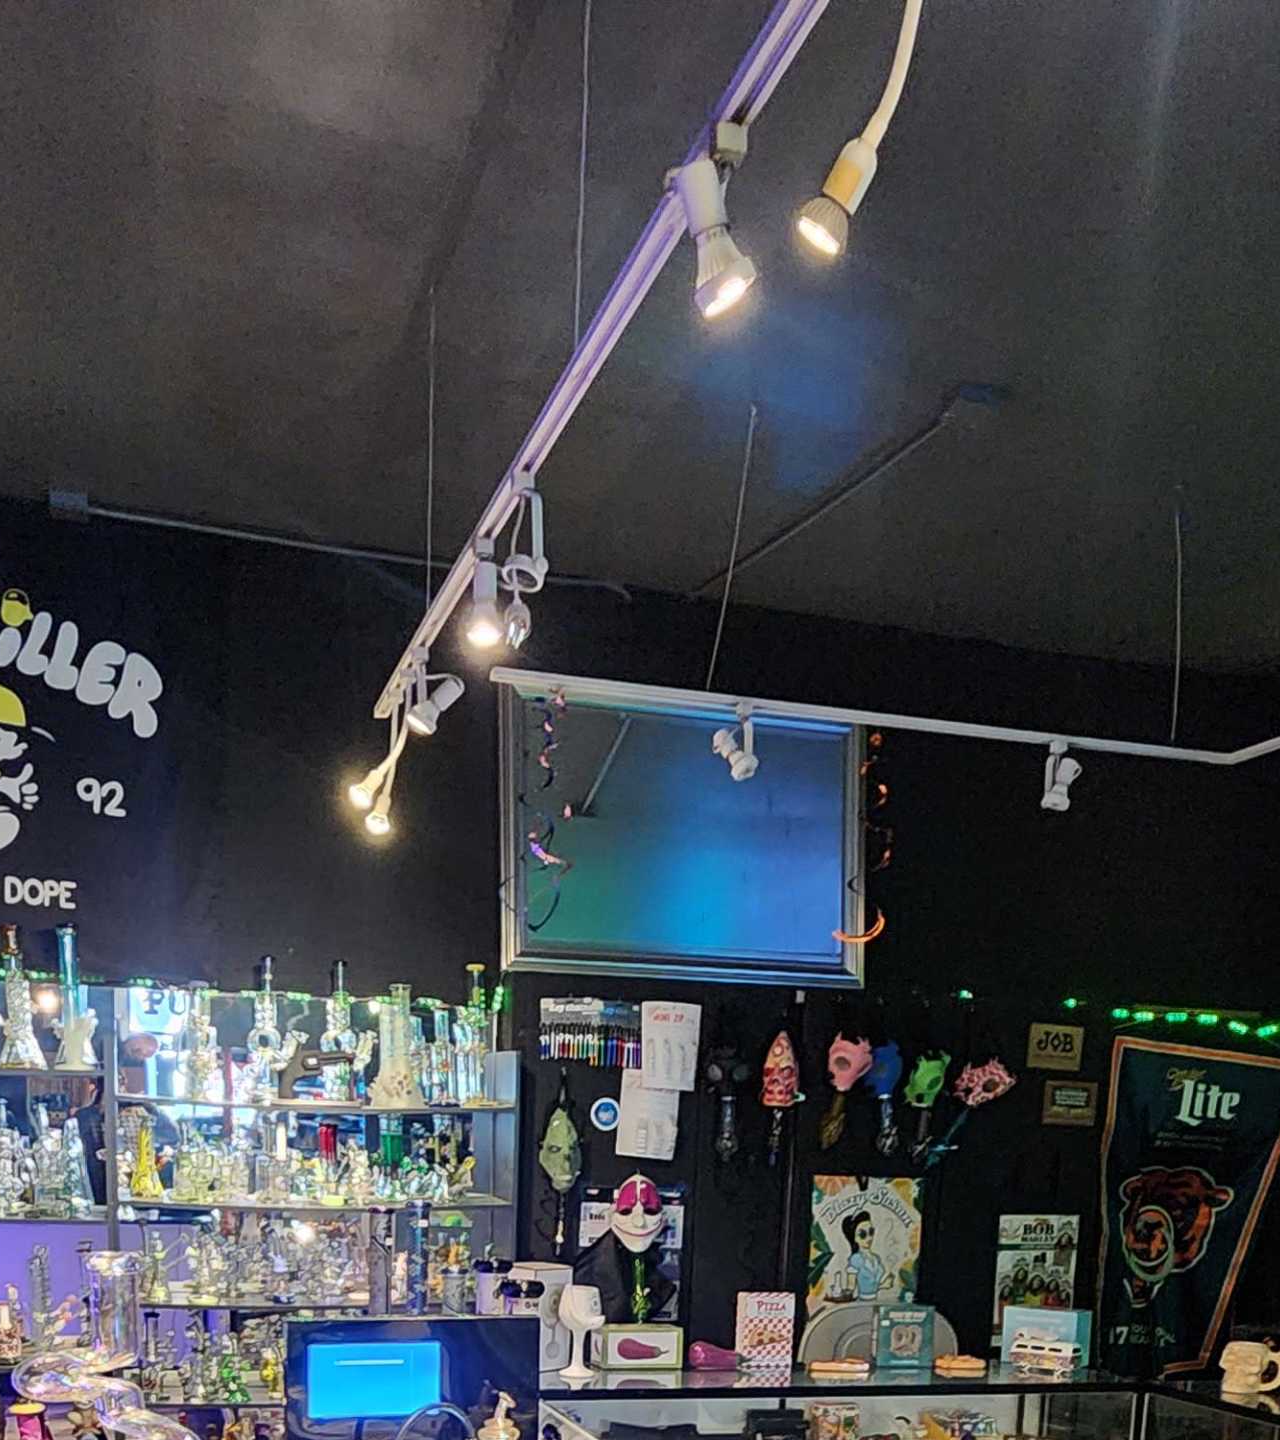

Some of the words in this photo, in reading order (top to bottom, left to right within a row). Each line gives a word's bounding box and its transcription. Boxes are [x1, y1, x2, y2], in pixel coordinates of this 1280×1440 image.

[76, 777, 127, 818] 92
[4, 875, 77, 909] DOPE
[1036, 1031, 1074, 1053] JOB
[1174, 1079, 1241, 1128] Lite
[1023, 1222, 1055, 1235] BOB
